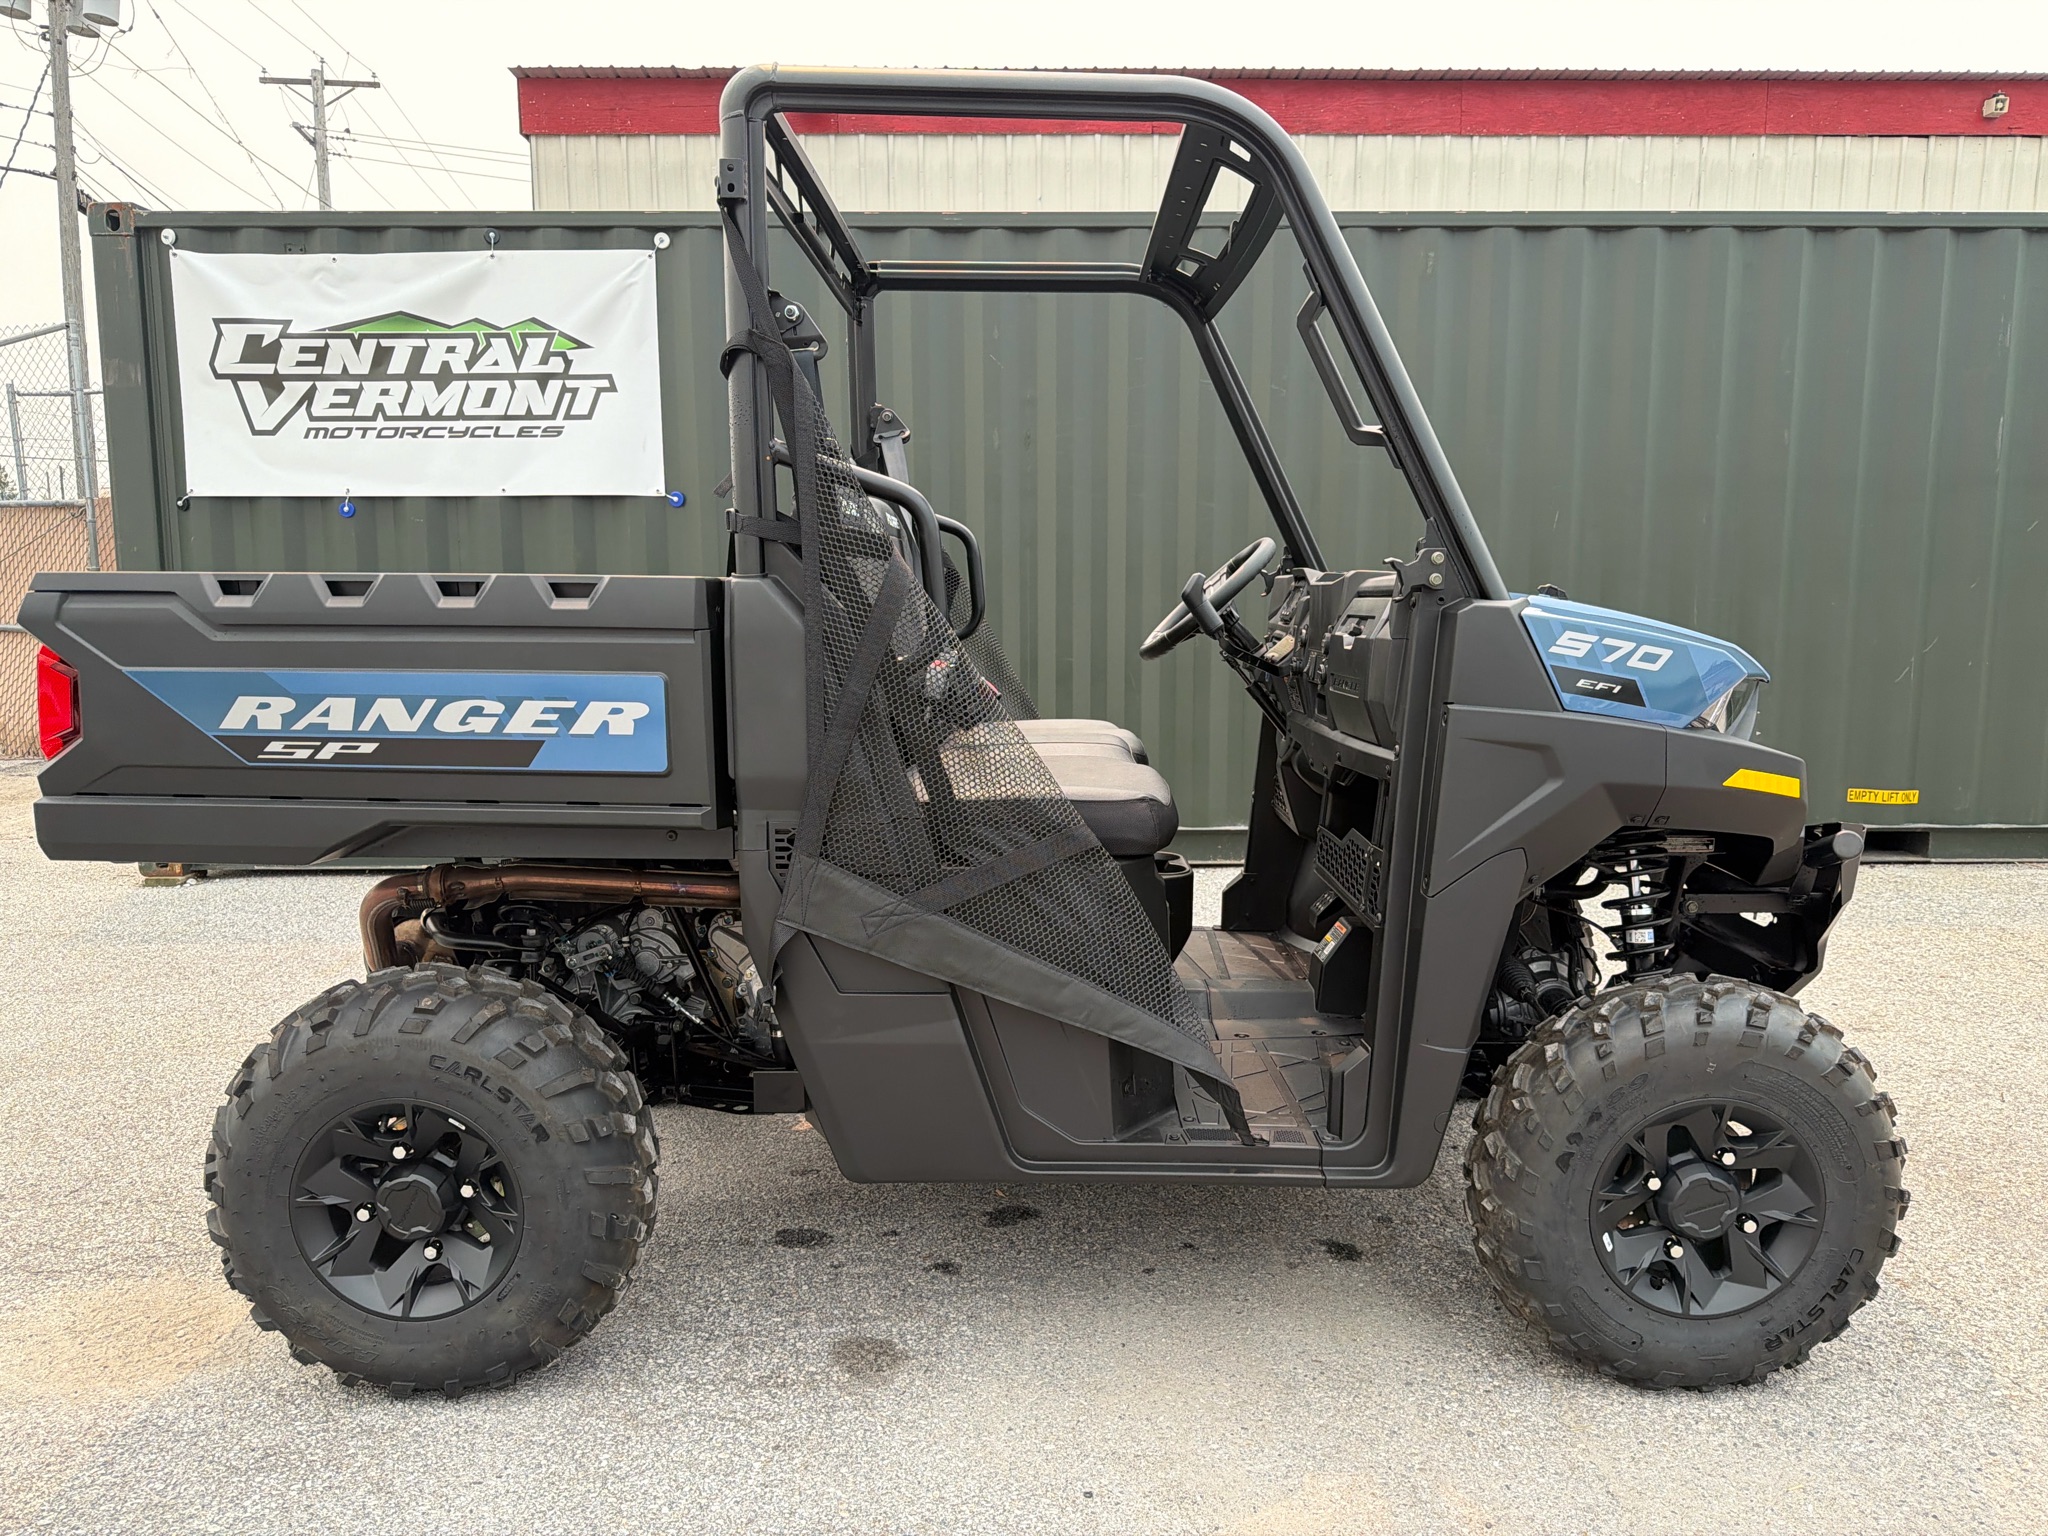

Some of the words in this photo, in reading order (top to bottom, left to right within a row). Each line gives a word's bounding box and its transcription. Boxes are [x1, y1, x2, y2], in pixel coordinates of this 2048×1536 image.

[209, 318, 580, 380] CENTRAL
[232, 375, 618, 436] VERMONT
[303, 426, 566, 440] MOTORCYCLES
[1548, 630, 1674, 672] 570
[1575, 678, 1623, 694] EFI
[218, 695, 650, 736] RANGER
[257, 741, 381, 761] SP
[1848, 789, 1880, 802] EMPTY
[1881, 790, 1900, 803] LIFT
[1901, 791, 1918, 803] ONLY
[428, 1054, 551, 1145] CARLSTAR
[1764, 1247, 1865, 1352] CARLSTAR
